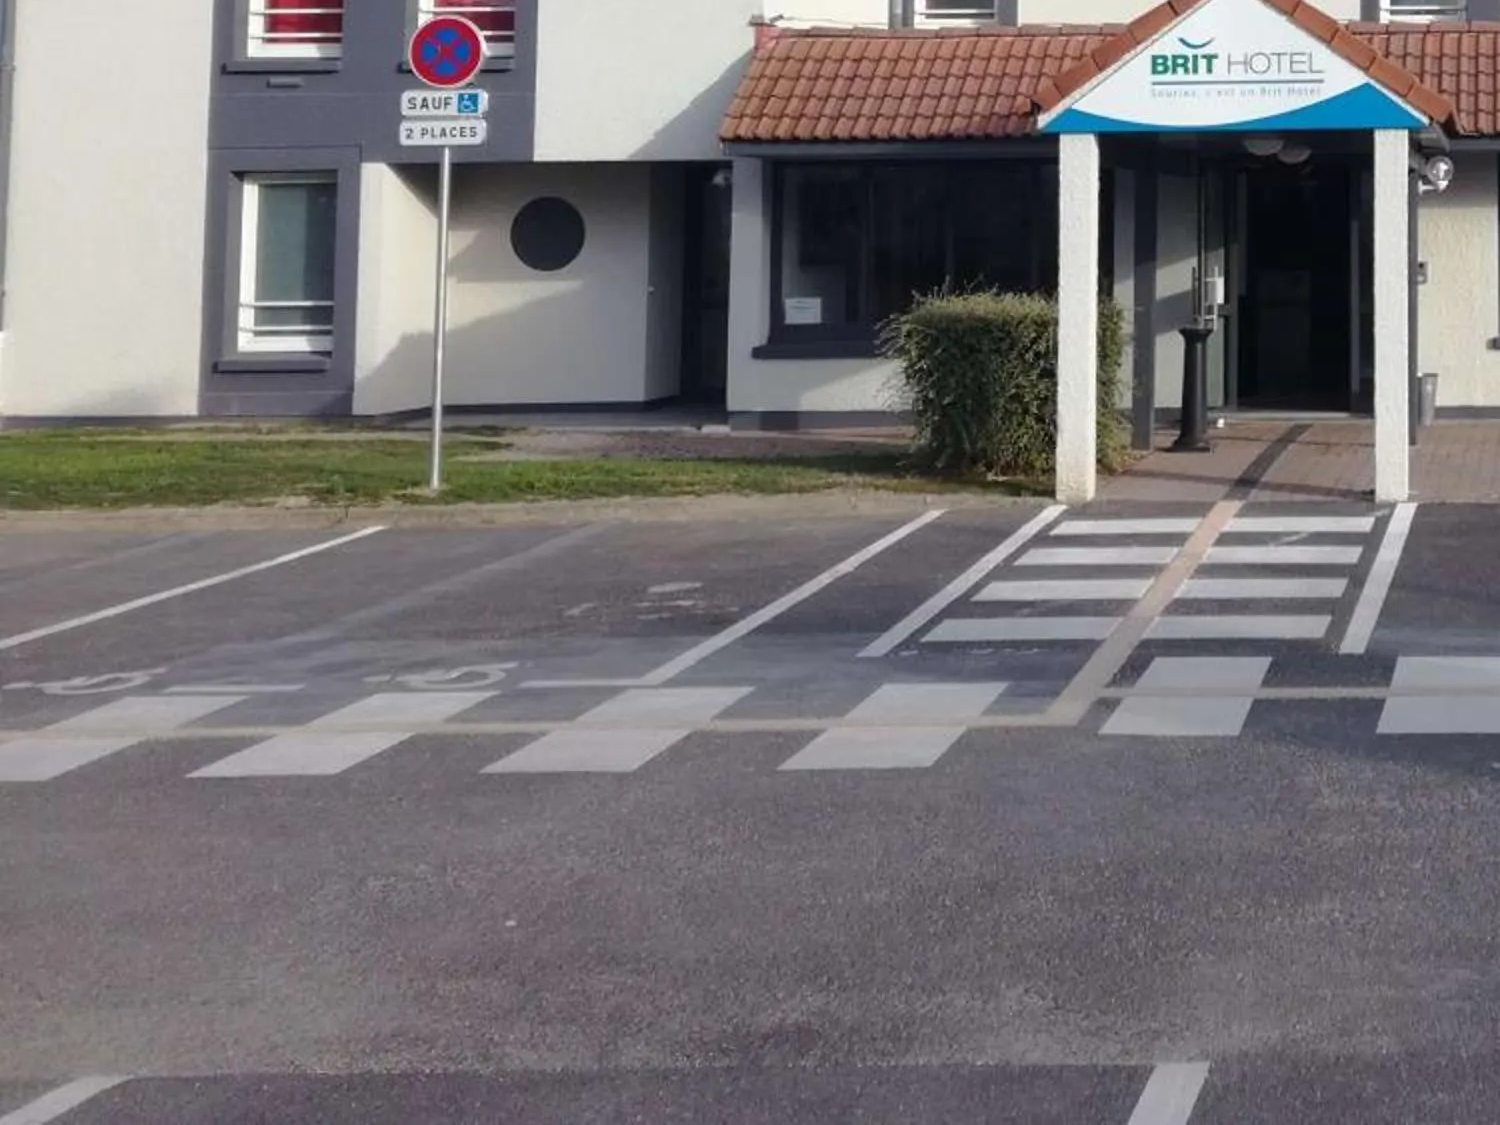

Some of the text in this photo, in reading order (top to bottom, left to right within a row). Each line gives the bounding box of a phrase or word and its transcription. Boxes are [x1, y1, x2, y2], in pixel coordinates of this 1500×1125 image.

[1151, 52, 1325, 75] BRIT HOTEL
[407, 96, 453, 110] SAUF
[404, 126, 478, 140] 2 PLACES
